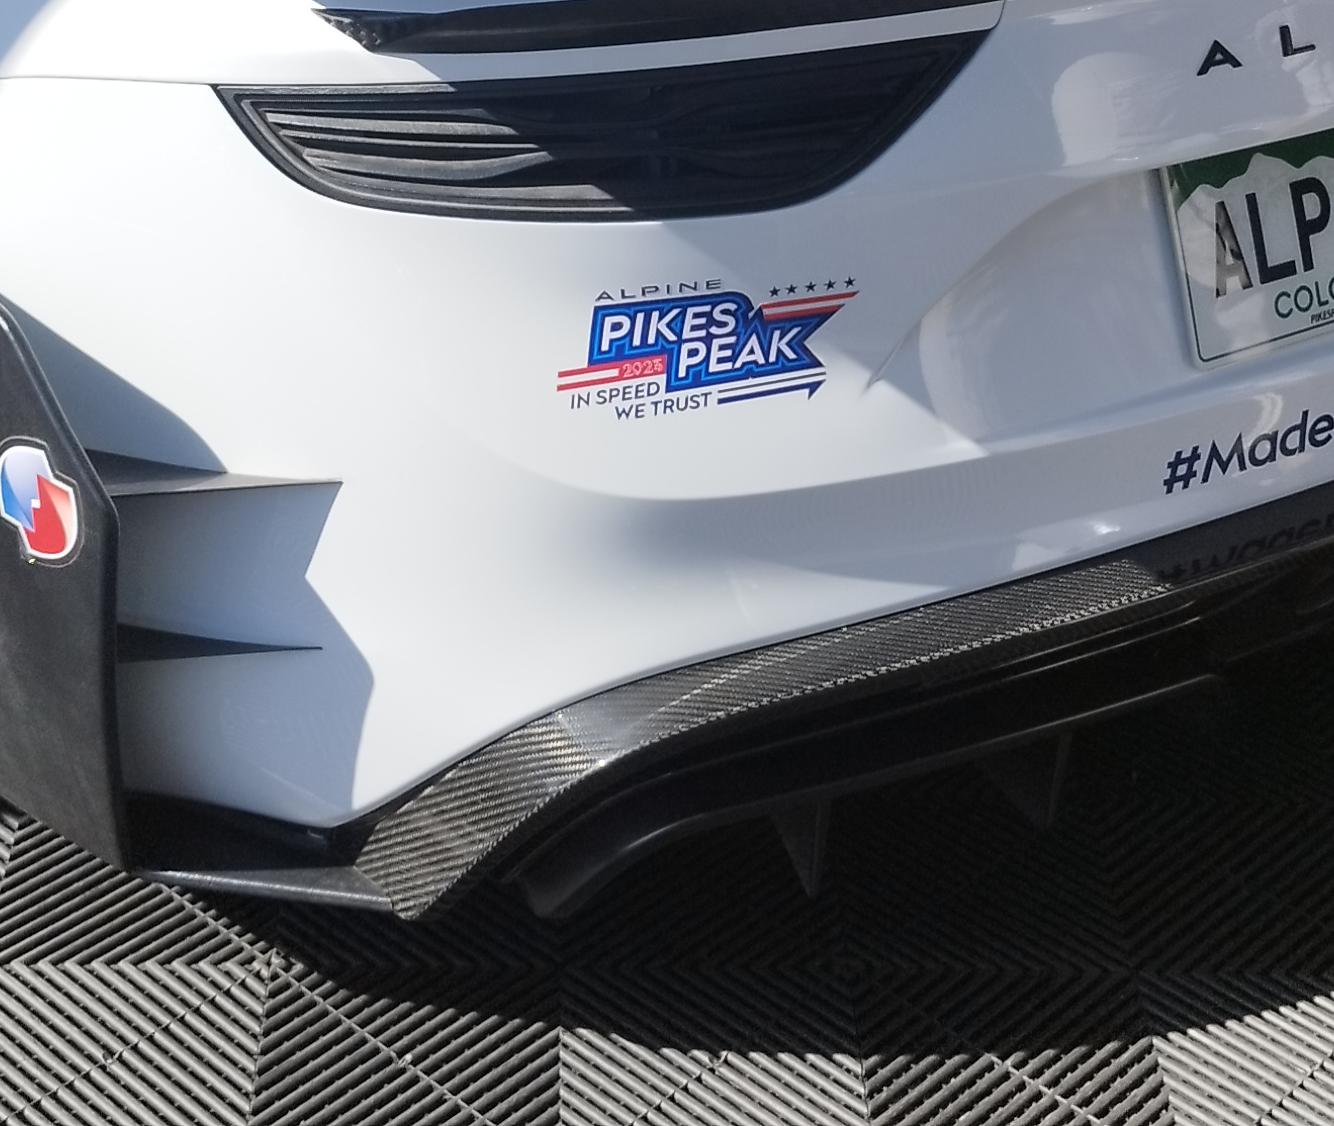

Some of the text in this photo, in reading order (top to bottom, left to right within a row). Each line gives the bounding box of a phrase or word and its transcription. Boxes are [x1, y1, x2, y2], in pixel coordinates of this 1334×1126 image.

[595, 279, 722, 302] ALPINE
[600, 302, 738, 352] PIKES
[678, 326, 802, 378] PEAK
[570, 381, 661, 410] IN SPEED
[615, 391, 713, 420] WE TRUST
